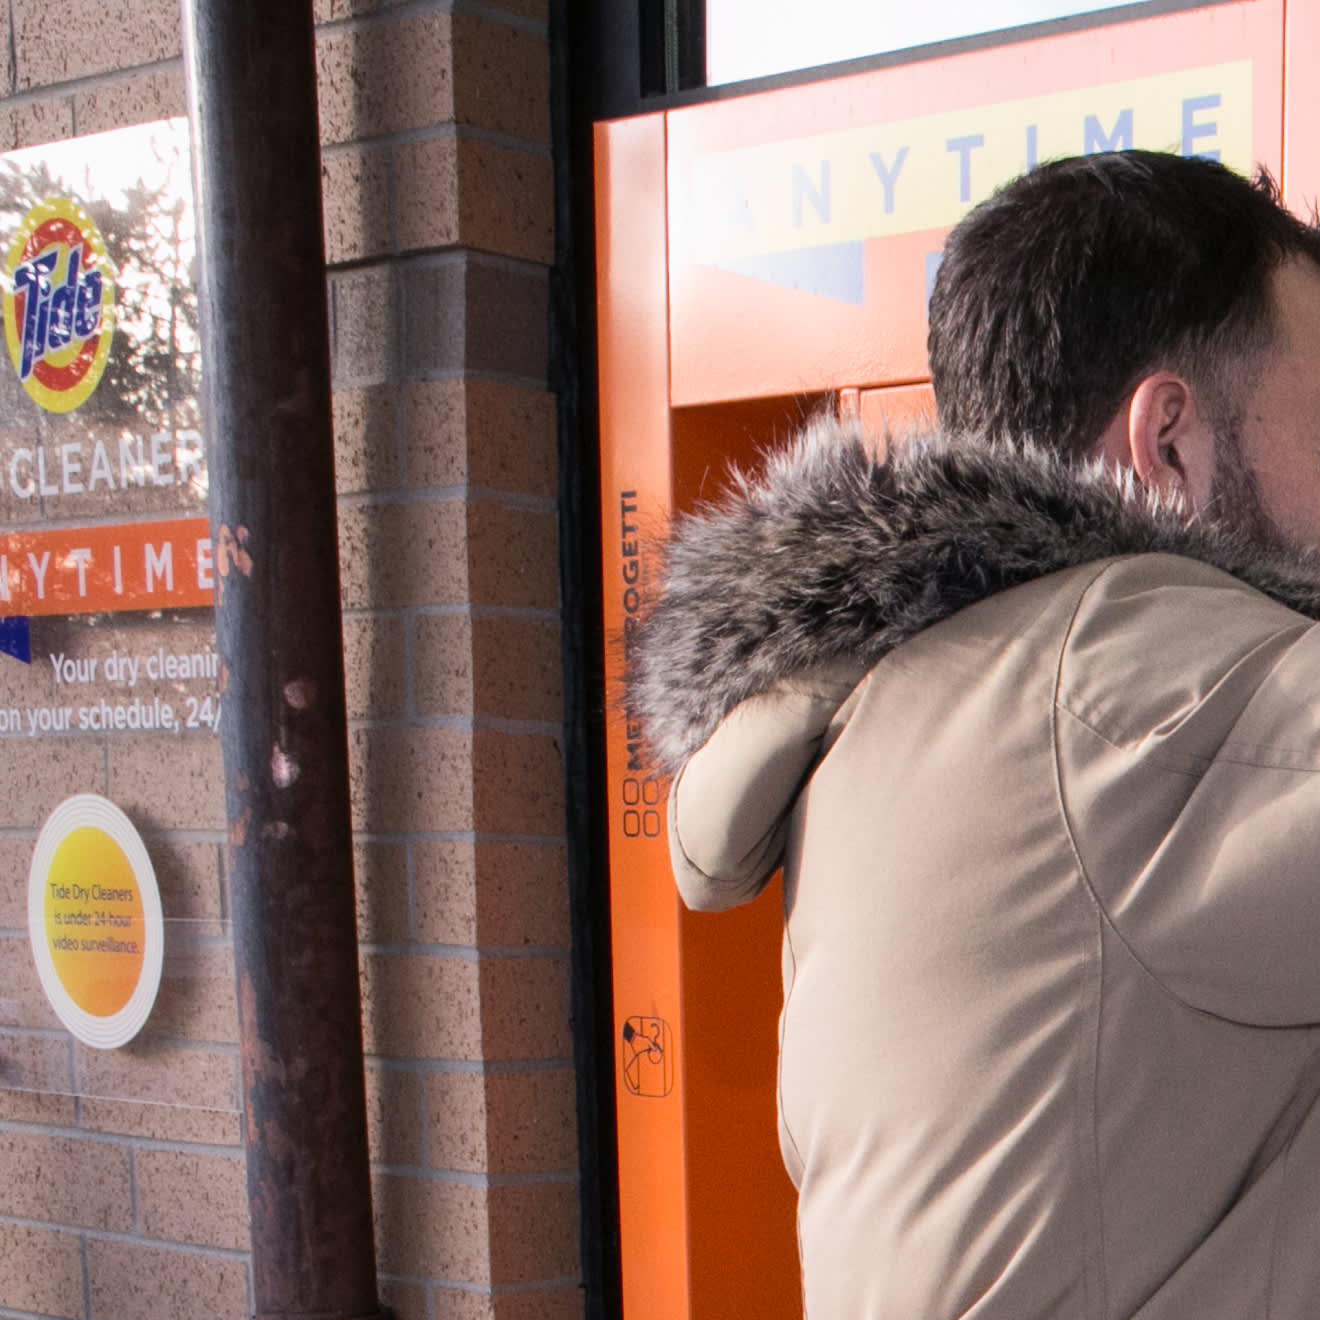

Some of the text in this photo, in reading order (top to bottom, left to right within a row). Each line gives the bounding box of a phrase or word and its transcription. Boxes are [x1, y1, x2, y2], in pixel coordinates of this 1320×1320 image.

[12, 243, 102, 382] Tide
[10, 429, 205, 499] CLEANER
[49, 652, 98, 684] Your
[103, 649, 140, 687] dry
[0, 696, 222, 738] on your schedule, 24/
[50, 883, 133, 904] Tide Dry Cleaners
